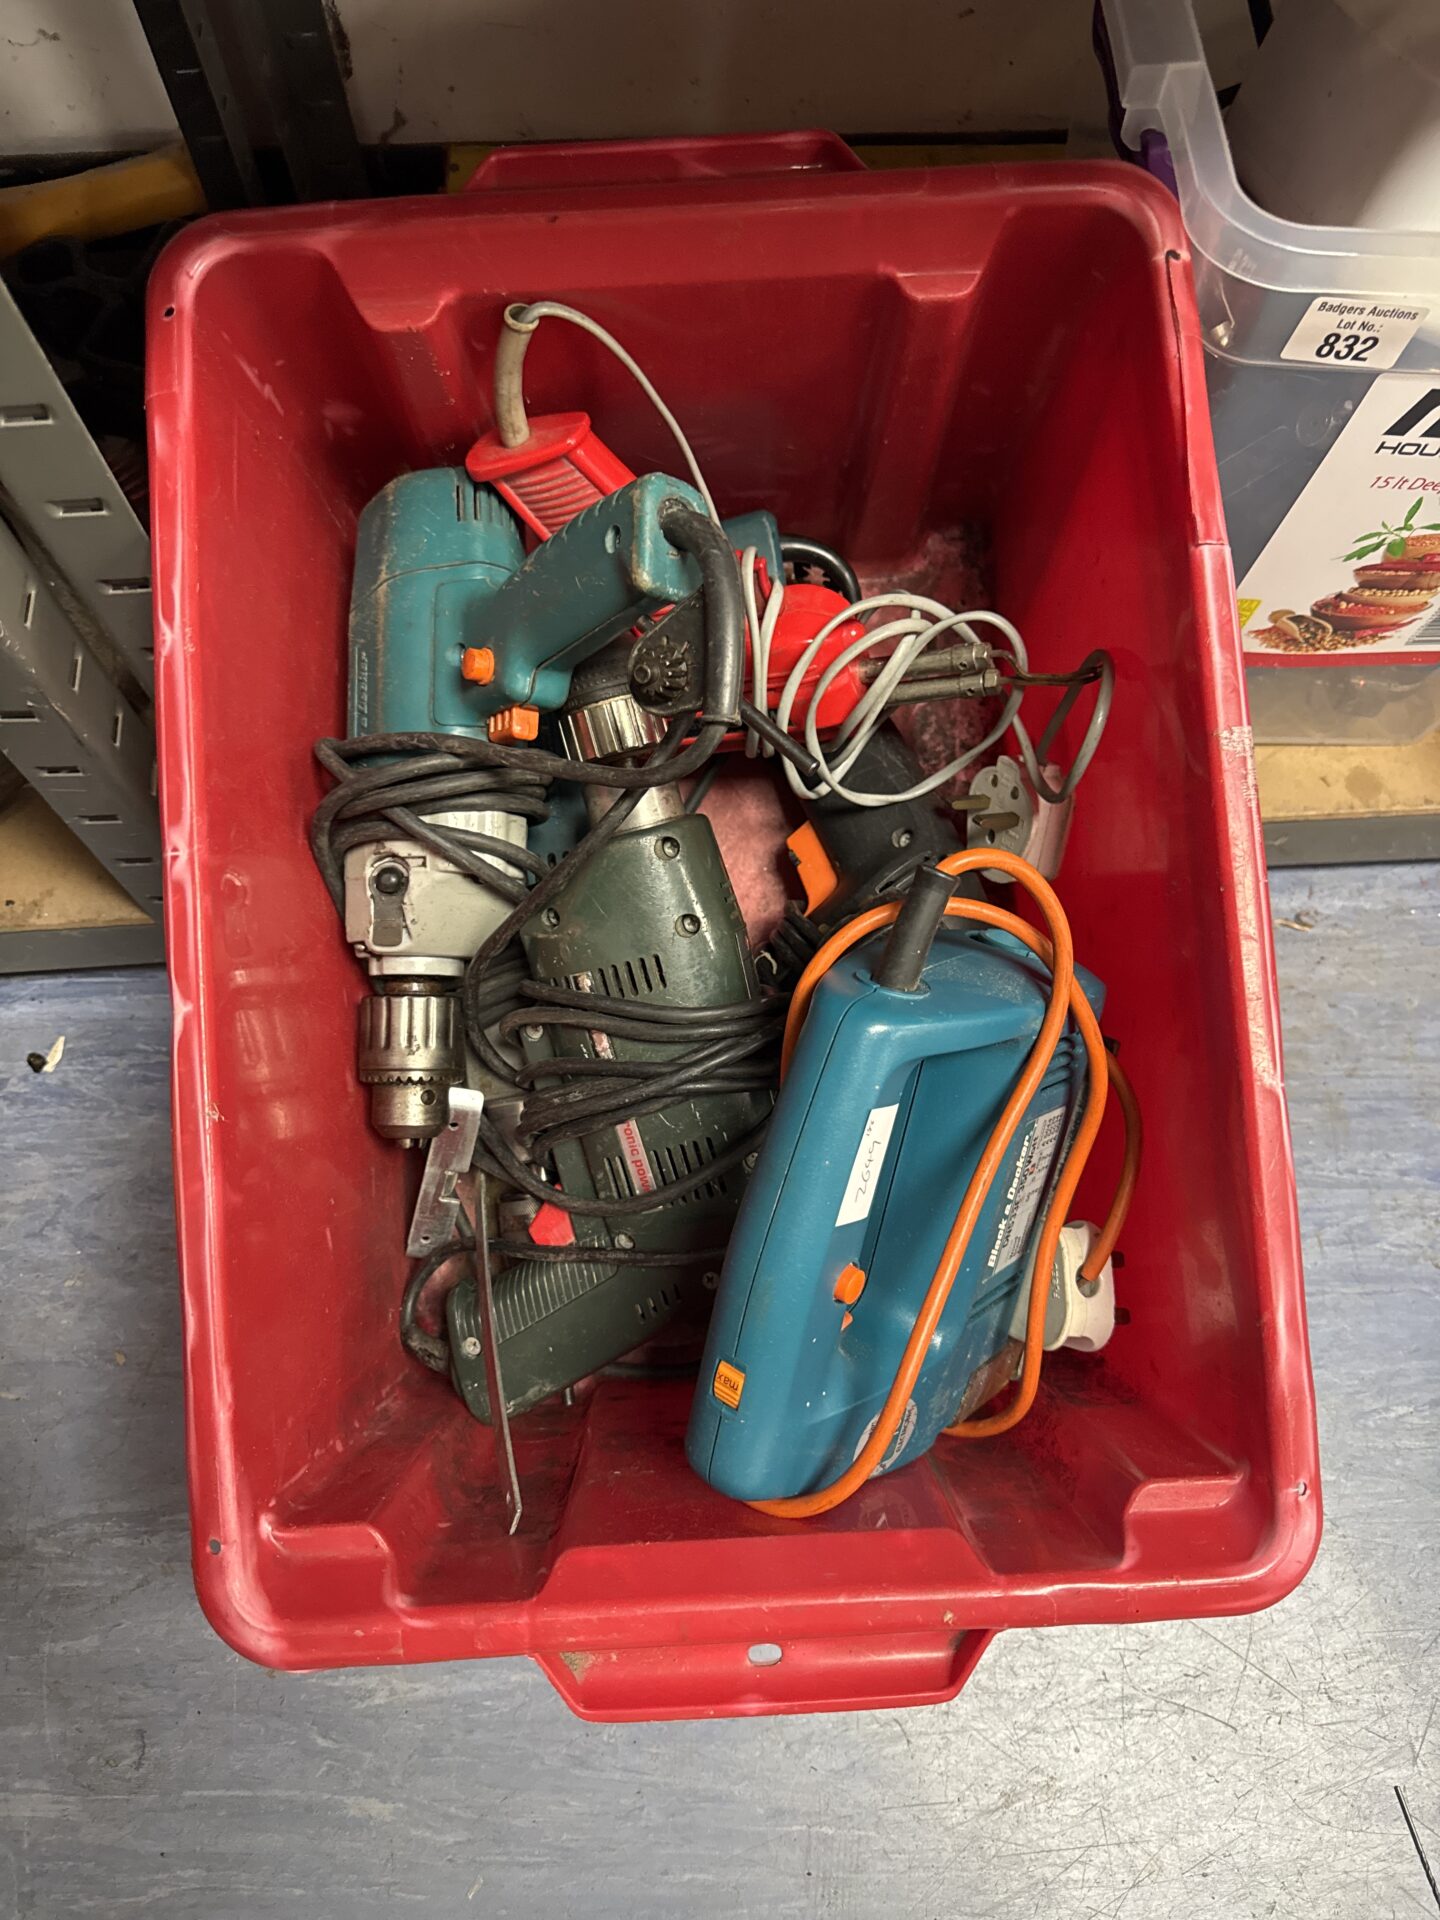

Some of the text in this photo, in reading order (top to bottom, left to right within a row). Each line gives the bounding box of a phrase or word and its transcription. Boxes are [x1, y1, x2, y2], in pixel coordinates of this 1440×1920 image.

[1317, 301, 1419, 320] Badgers Auctions
[1336, 319, 1356, 330] Lot
[1315, 332, 1379, 362] 832
[1374, 441, 1440, 457] HOU
[1370, 476, 1395, 489] 15
[987, 1218, 1007, 1267] Black
[1007, 1134, 1030, 1200] Decker
[717, 1374, 740, 1391] max
